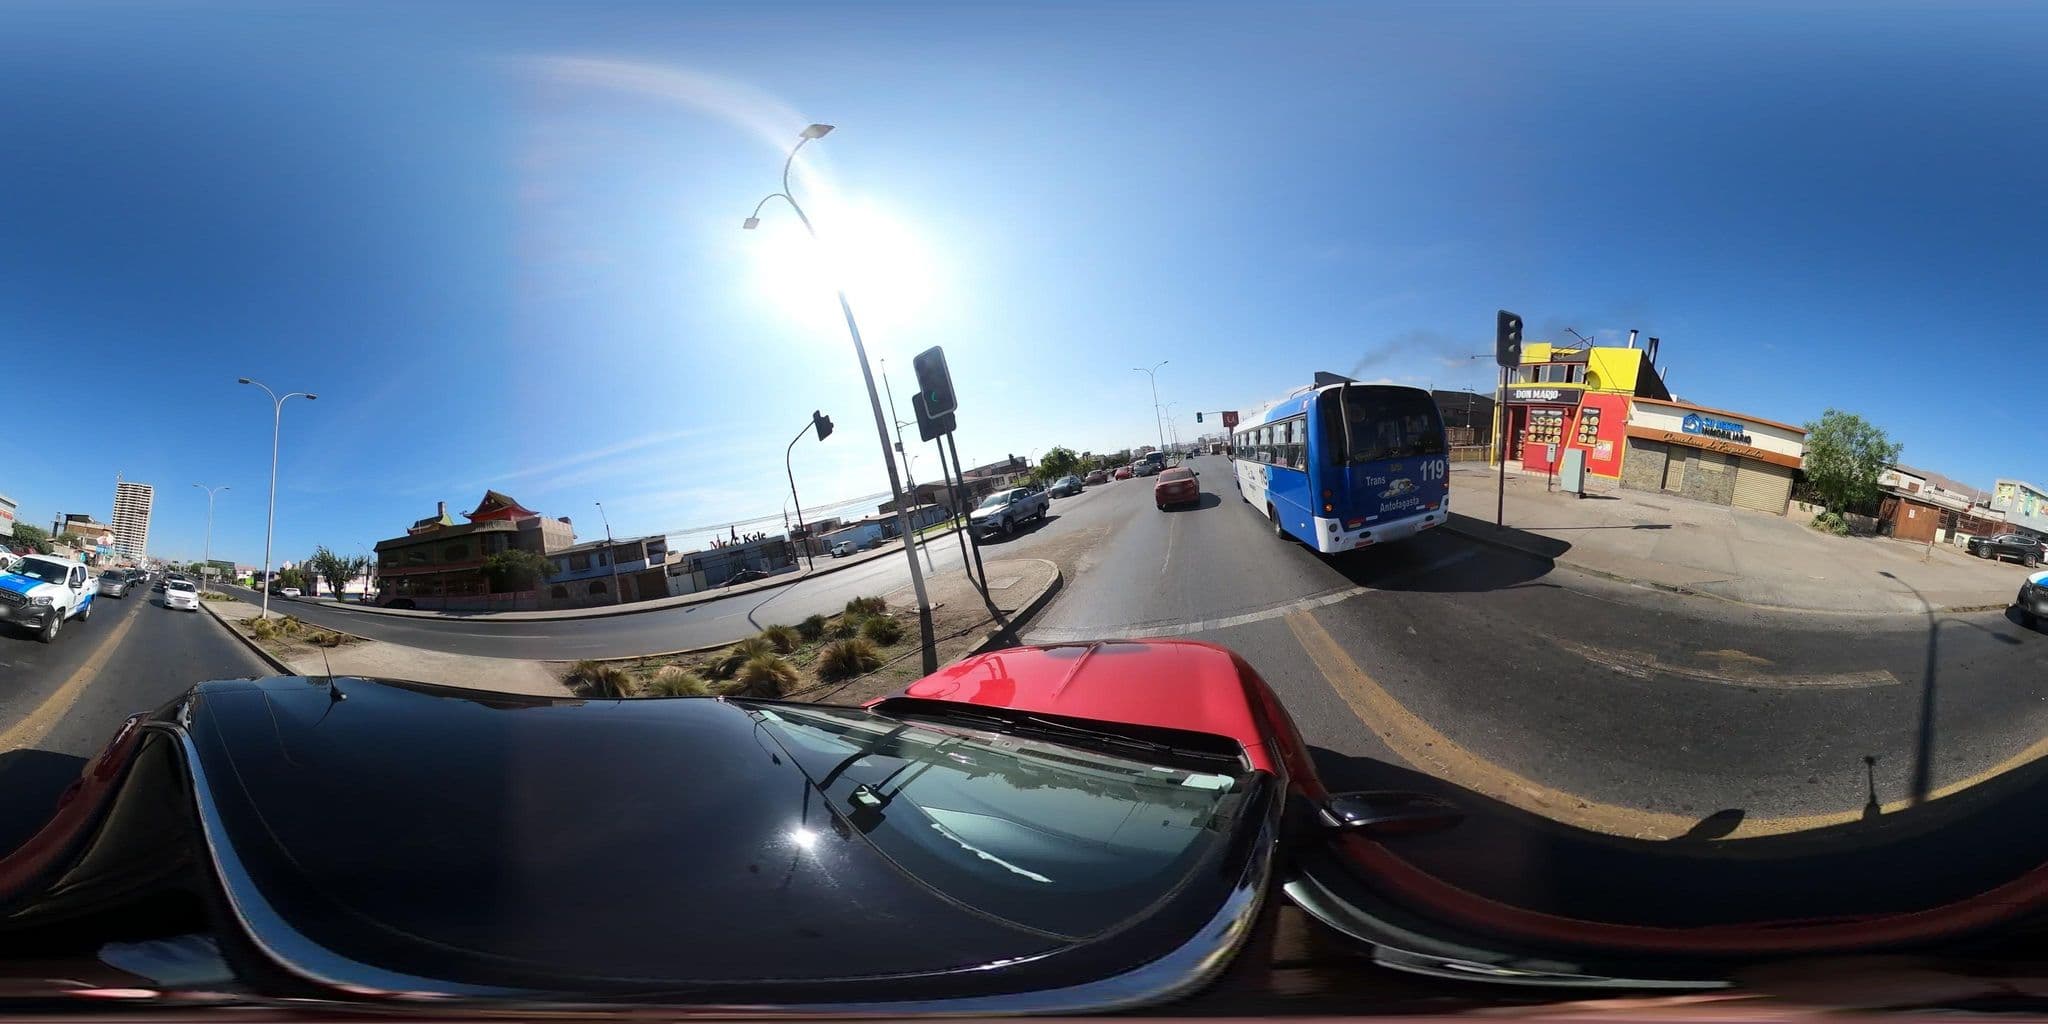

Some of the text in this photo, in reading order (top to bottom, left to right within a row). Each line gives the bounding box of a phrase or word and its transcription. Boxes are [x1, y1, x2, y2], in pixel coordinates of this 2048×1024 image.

[1515, 390, 1531, 399] DON
[1533, 390, 1558, 400] MARIO
[1420, 460, 1444, 481] 119
[1365, 476, 1386, 487] Trans
[1380, 497, 1420, 513] Antofagasta
